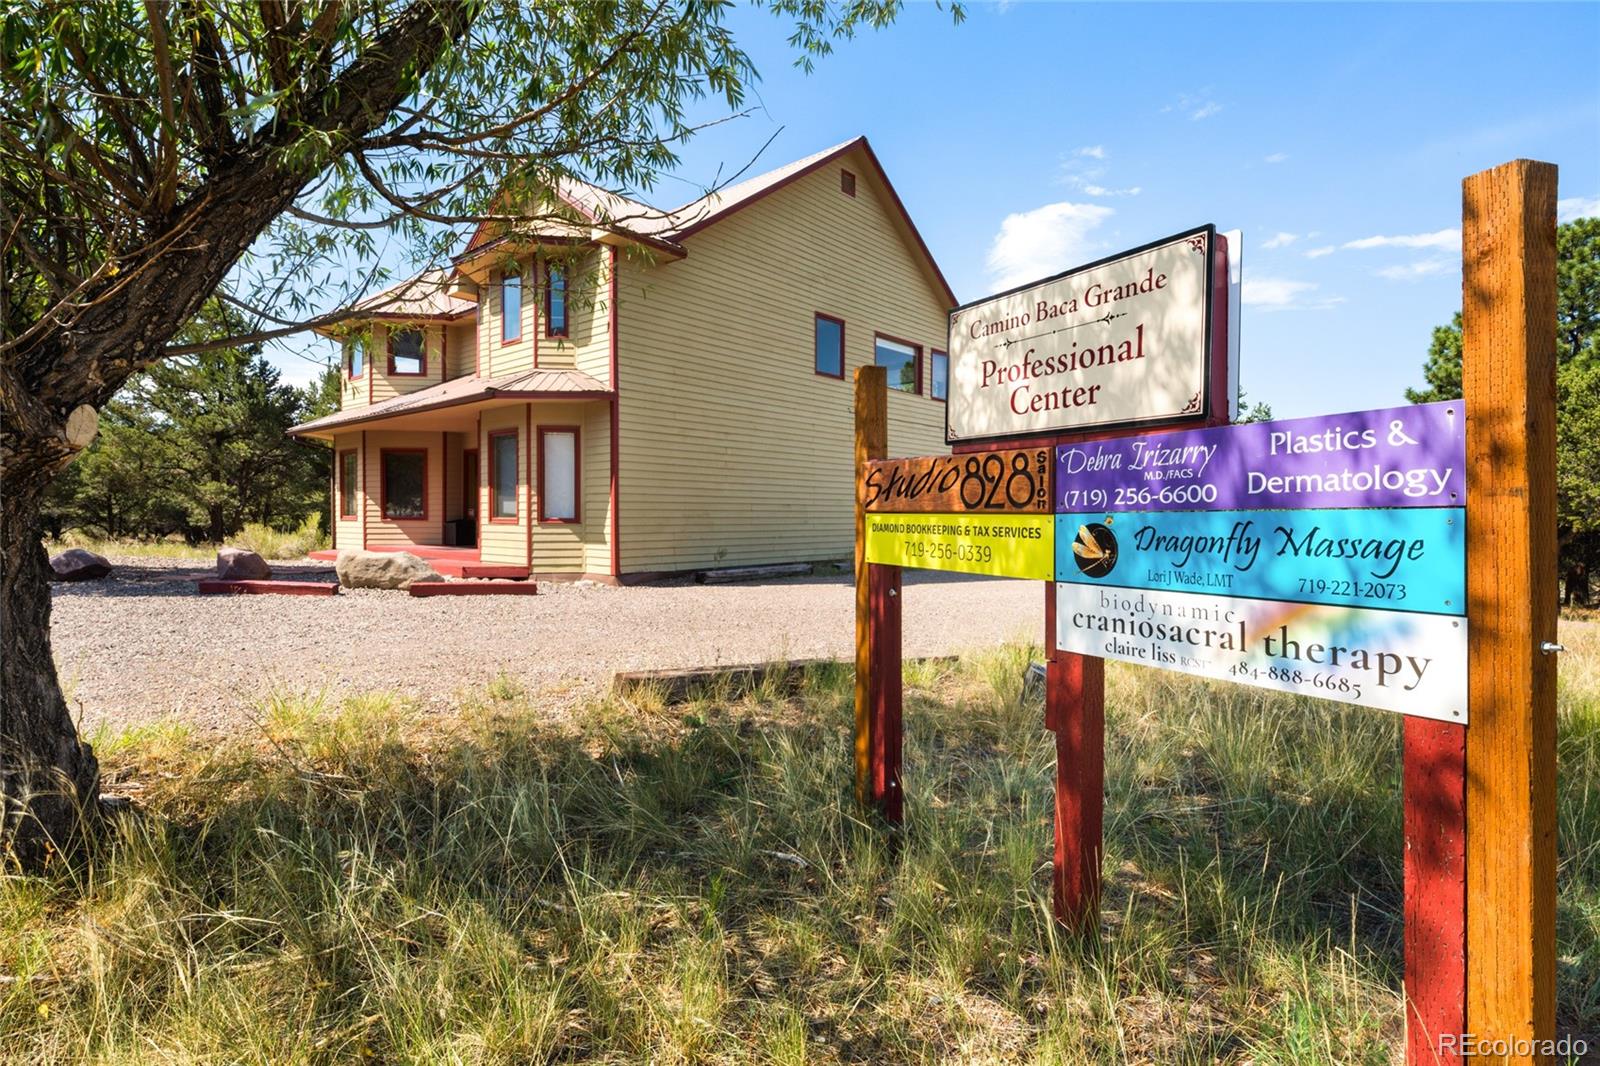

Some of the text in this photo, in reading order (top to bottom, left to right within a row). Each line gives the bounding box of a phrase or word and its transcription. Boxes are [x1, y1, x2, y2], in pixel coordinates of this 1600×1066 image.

[970, 267, 1168, 340] Camino Baca Grande
[980, 323, 1146, 389] Professional
[1010, 384, 1102, 416] Center
[1270, 419, 1419, 456] Plastics &
[1060, 441, 1217, 478] Debra Irizarry
[1143, 468, 1194, 481] M.D./FACS
[865, 452, 1036, 510] Studio 828
[1064, 483, 1218, 509] (719) 256-6600
[1247, 464, 1454, 498] Dermatology
[872, 523, 1042, 539] DIAMOND BOOKKEEPING & TAX SERVICES
[904, 541, 992, 563] 719-256-0339
[1134, 520, 1426, 580] Dragonfly Massage
[1148, 569, 1167, 583] Lori
[1206, 573, 1235, 588] LMT
[1298, 578, 1407, 600] 719-221-2073
[1100, 590, 1235, 624] biodynamic
[1072, 611, 1433, 691] craniosacral therapy
[1104, 637, 1147, 659] claire
[1151, 643, 1177, 664] liss
[1228, 661, 1362, 700] 484-888-6685
